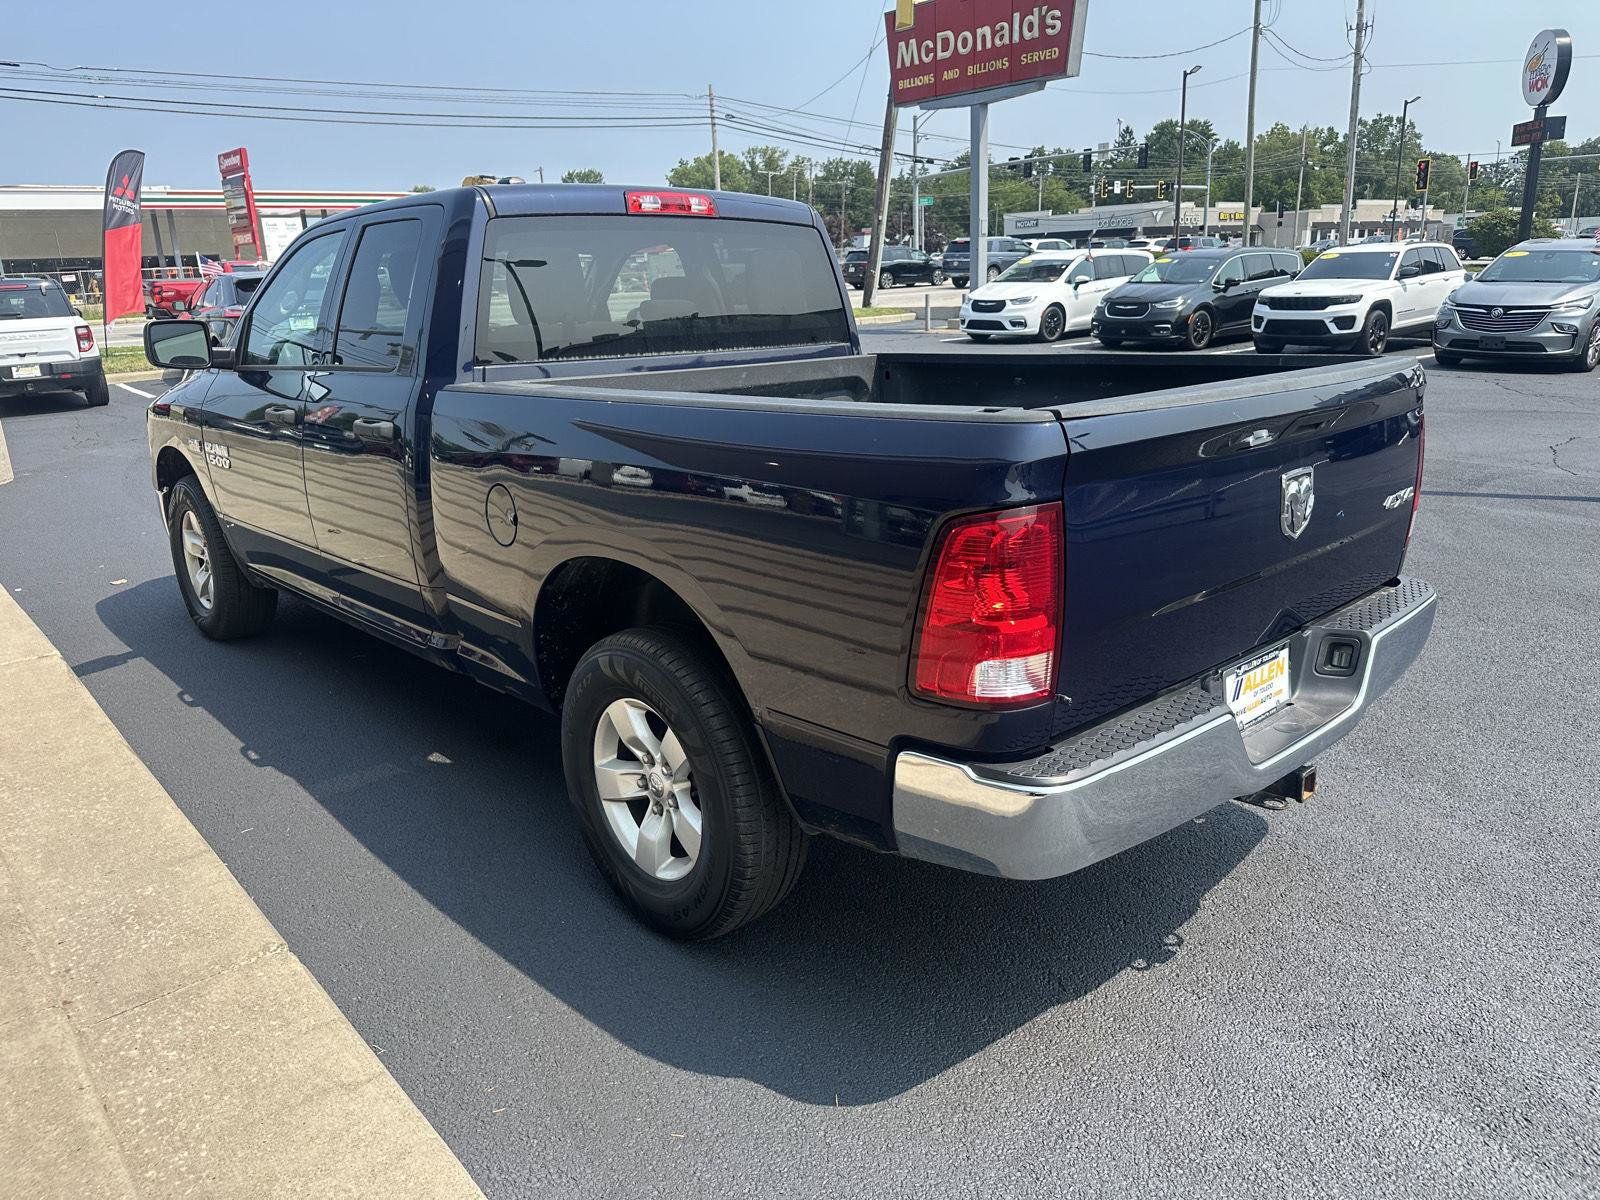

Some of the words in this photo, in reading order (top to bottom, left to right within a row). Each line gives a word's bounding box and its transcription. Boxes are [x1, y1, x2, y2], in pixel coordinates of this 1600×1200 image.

[896, 5, 1062, 69] McDonald's
[898, 73, 935, 90] BILLIONS
[942, 68, 960, 81] AND
[967, 57, 1009, 76] BILLIONS
[1021, 47, 1060, 65] SERVED
[1016, 219, 1037, 229] NOTARY
[204, 441, 229, 458] RAM
[206, 453, 230, 469] 1500
[1242, 657, 1285, 695] ALLEN
